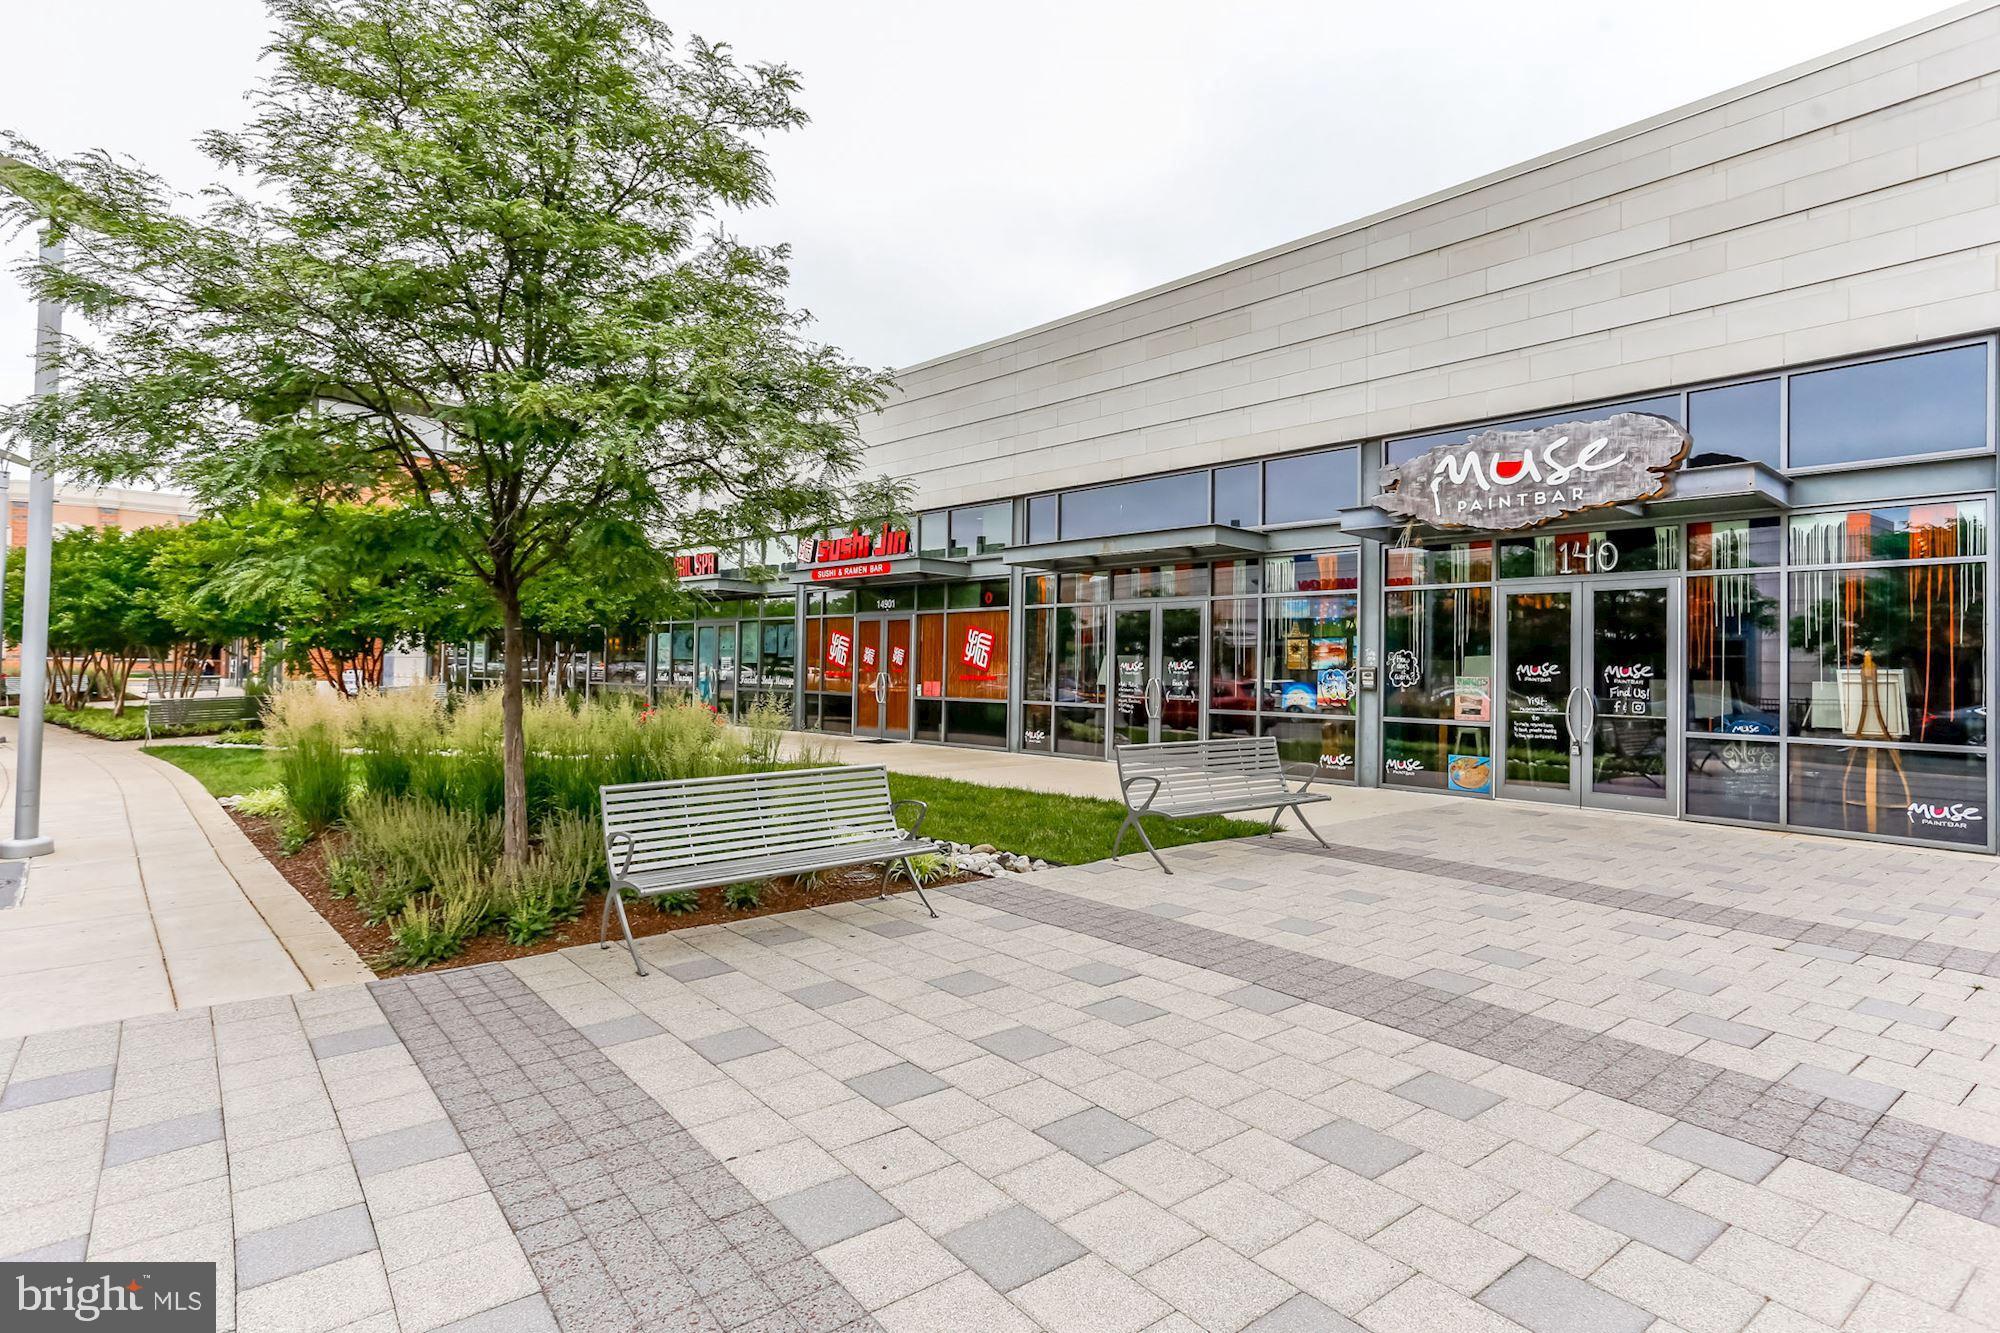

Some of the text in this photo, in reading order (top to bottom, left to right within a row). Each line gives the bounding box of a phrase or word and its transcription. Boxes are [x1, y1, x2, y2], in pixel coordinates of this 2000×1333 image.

[1457, 488, 1585, 512] PAINTBAR
[694, 553, 714, 576] SPA
[1559, 541, 1619, 574] 140
[817, 564, 883, 578] SUSHI & RAMEN BAR
[877, 599, 896, 609] 14901
[1610, 686, 1650, 700] Find Us!
[1922, 819, 1967, 829] PAINTBAR
